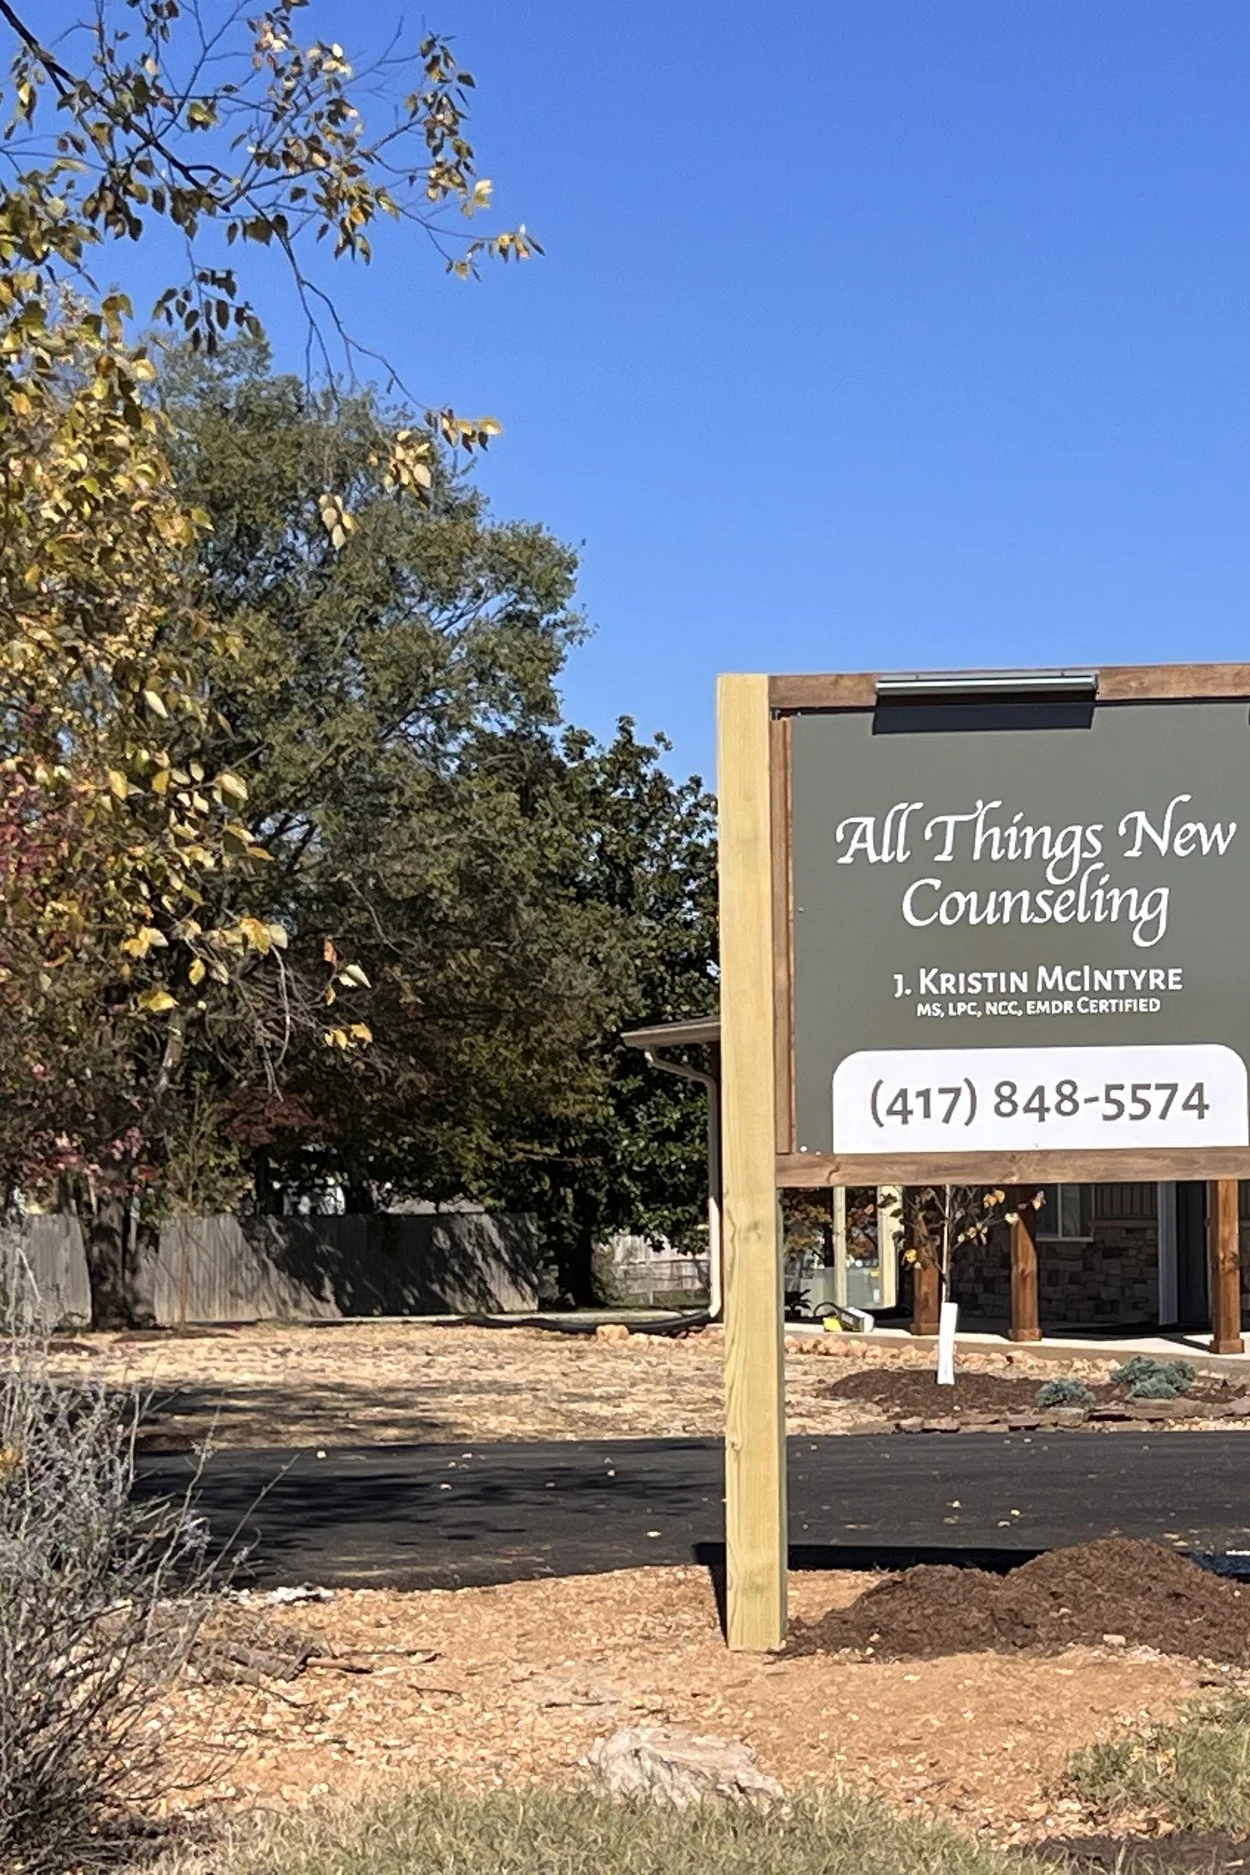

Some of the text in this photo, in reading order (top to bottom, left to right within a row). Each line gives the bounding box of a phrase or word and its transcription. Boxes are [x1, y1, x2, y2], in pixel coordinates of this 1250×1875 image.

[834, 793, 1238, 886] All Things New
[901, 861, 1170, 948] Counseling
[916, 1002, 948, 1020] MS,
[947, 1001, 985, 1019] LPC,
[985, 1000, 1026, 1018] NCC,
[1026, 998, 1075, 1016] EMDR
[871, 1077, 1211, 1129] (417) 848-5574
